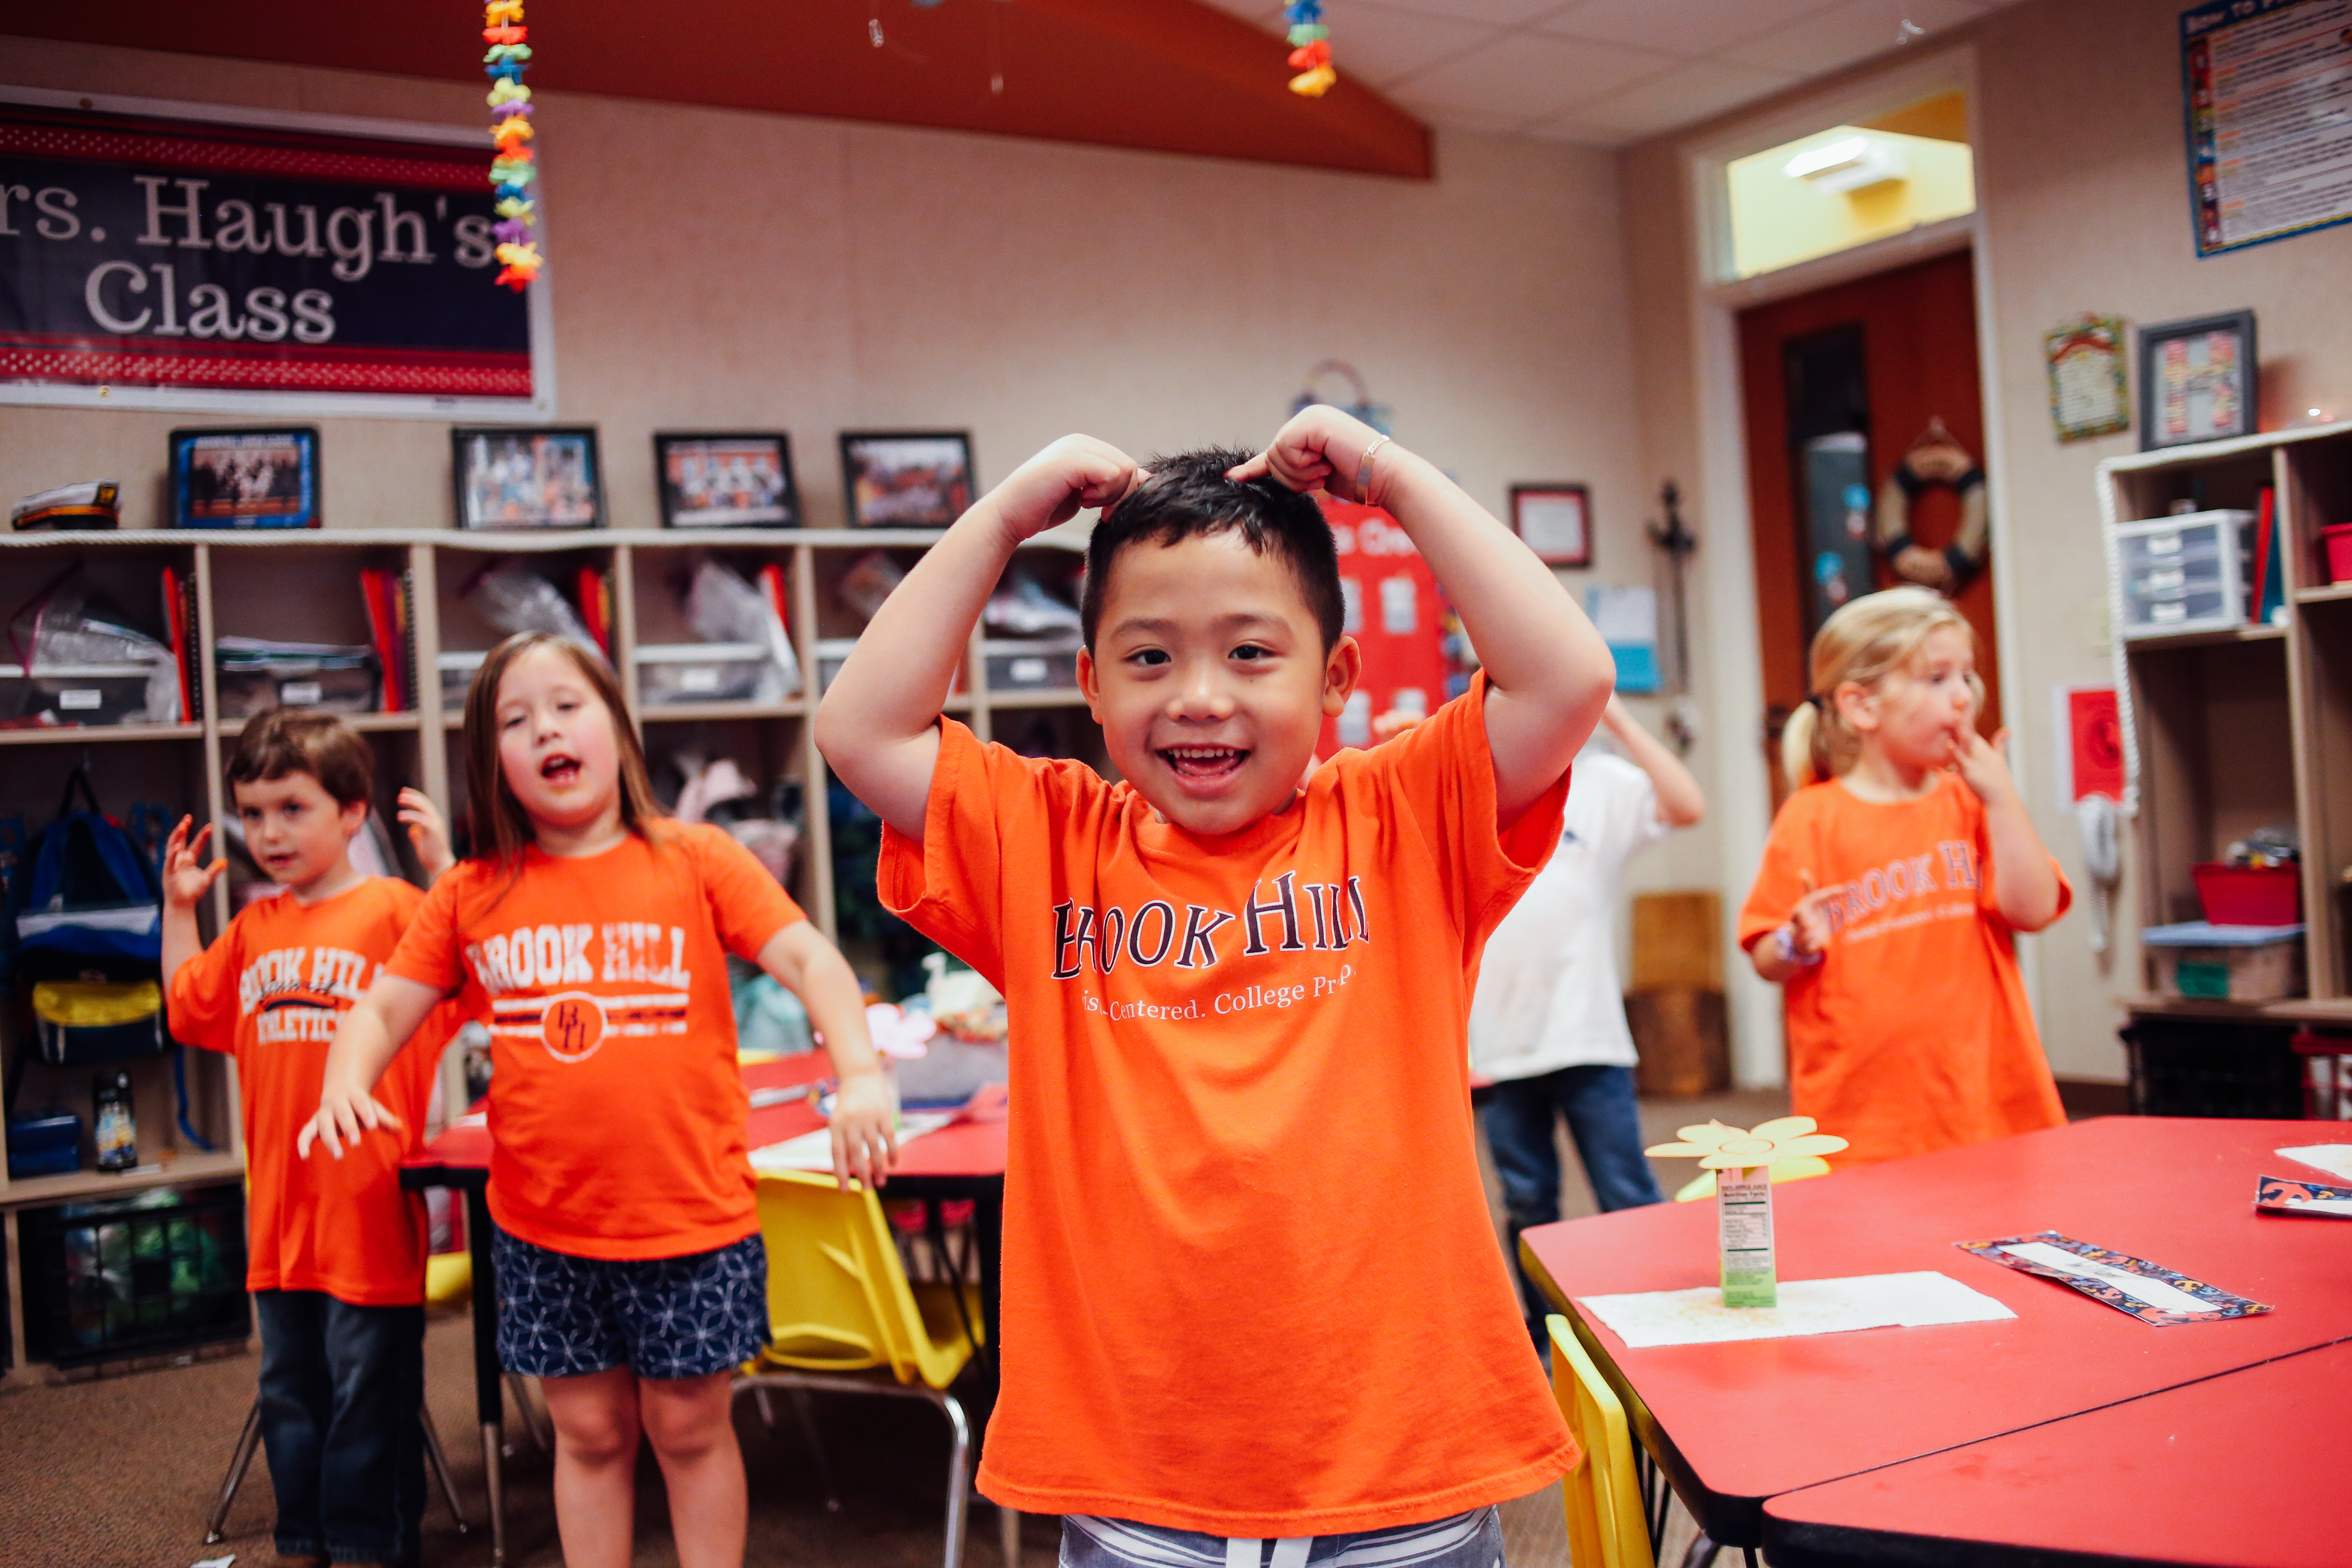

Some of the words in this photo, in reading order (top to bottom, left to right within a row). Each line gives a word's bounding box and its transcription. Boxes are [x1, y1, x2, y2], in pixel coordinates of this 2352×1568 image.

[0, 184, 106, 243] rs.
[134, 174, 493, 282] Haugh's
[85, 260, 336, 343] Class
[1051, 897, 1236, 980] BROOK
[1243, 870, 1370, 957] HILL
[1214, 984, 1305, 1014] College
[1313, 964, 1356, 997] Prp.
